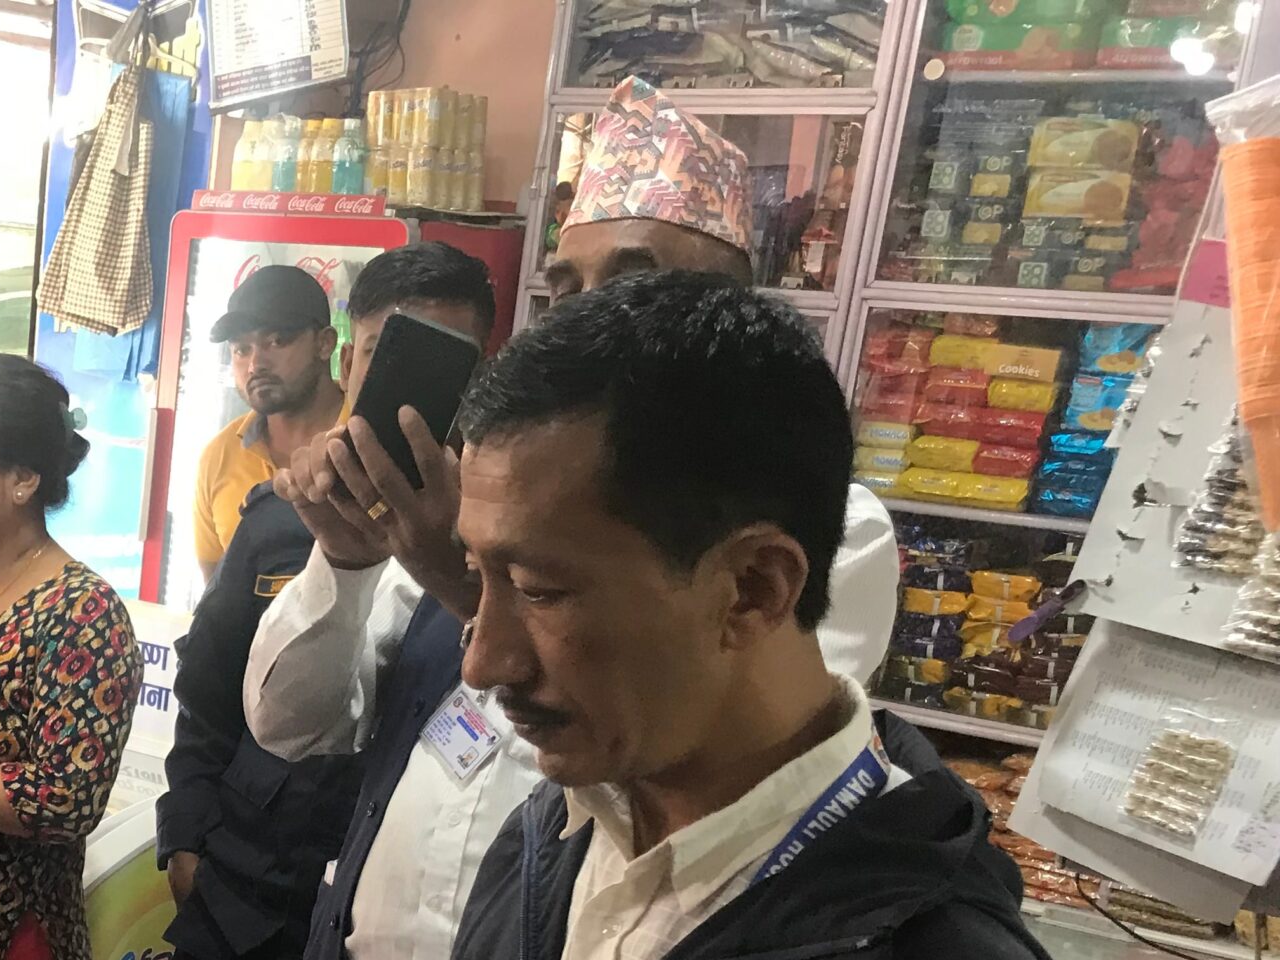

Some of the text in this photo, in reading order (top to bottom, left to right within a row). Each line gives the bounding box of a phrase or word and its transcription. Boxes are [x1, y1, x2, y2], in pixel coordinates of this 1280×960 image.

[978, 155, 1013, 172] TOP
[970, 204, 1004, 220] TOP
[1071, 257, 1105, 273] TOP
[998, 363, 1041, 379] Cookies
[801, 768, 876, 840] DAMAULI
